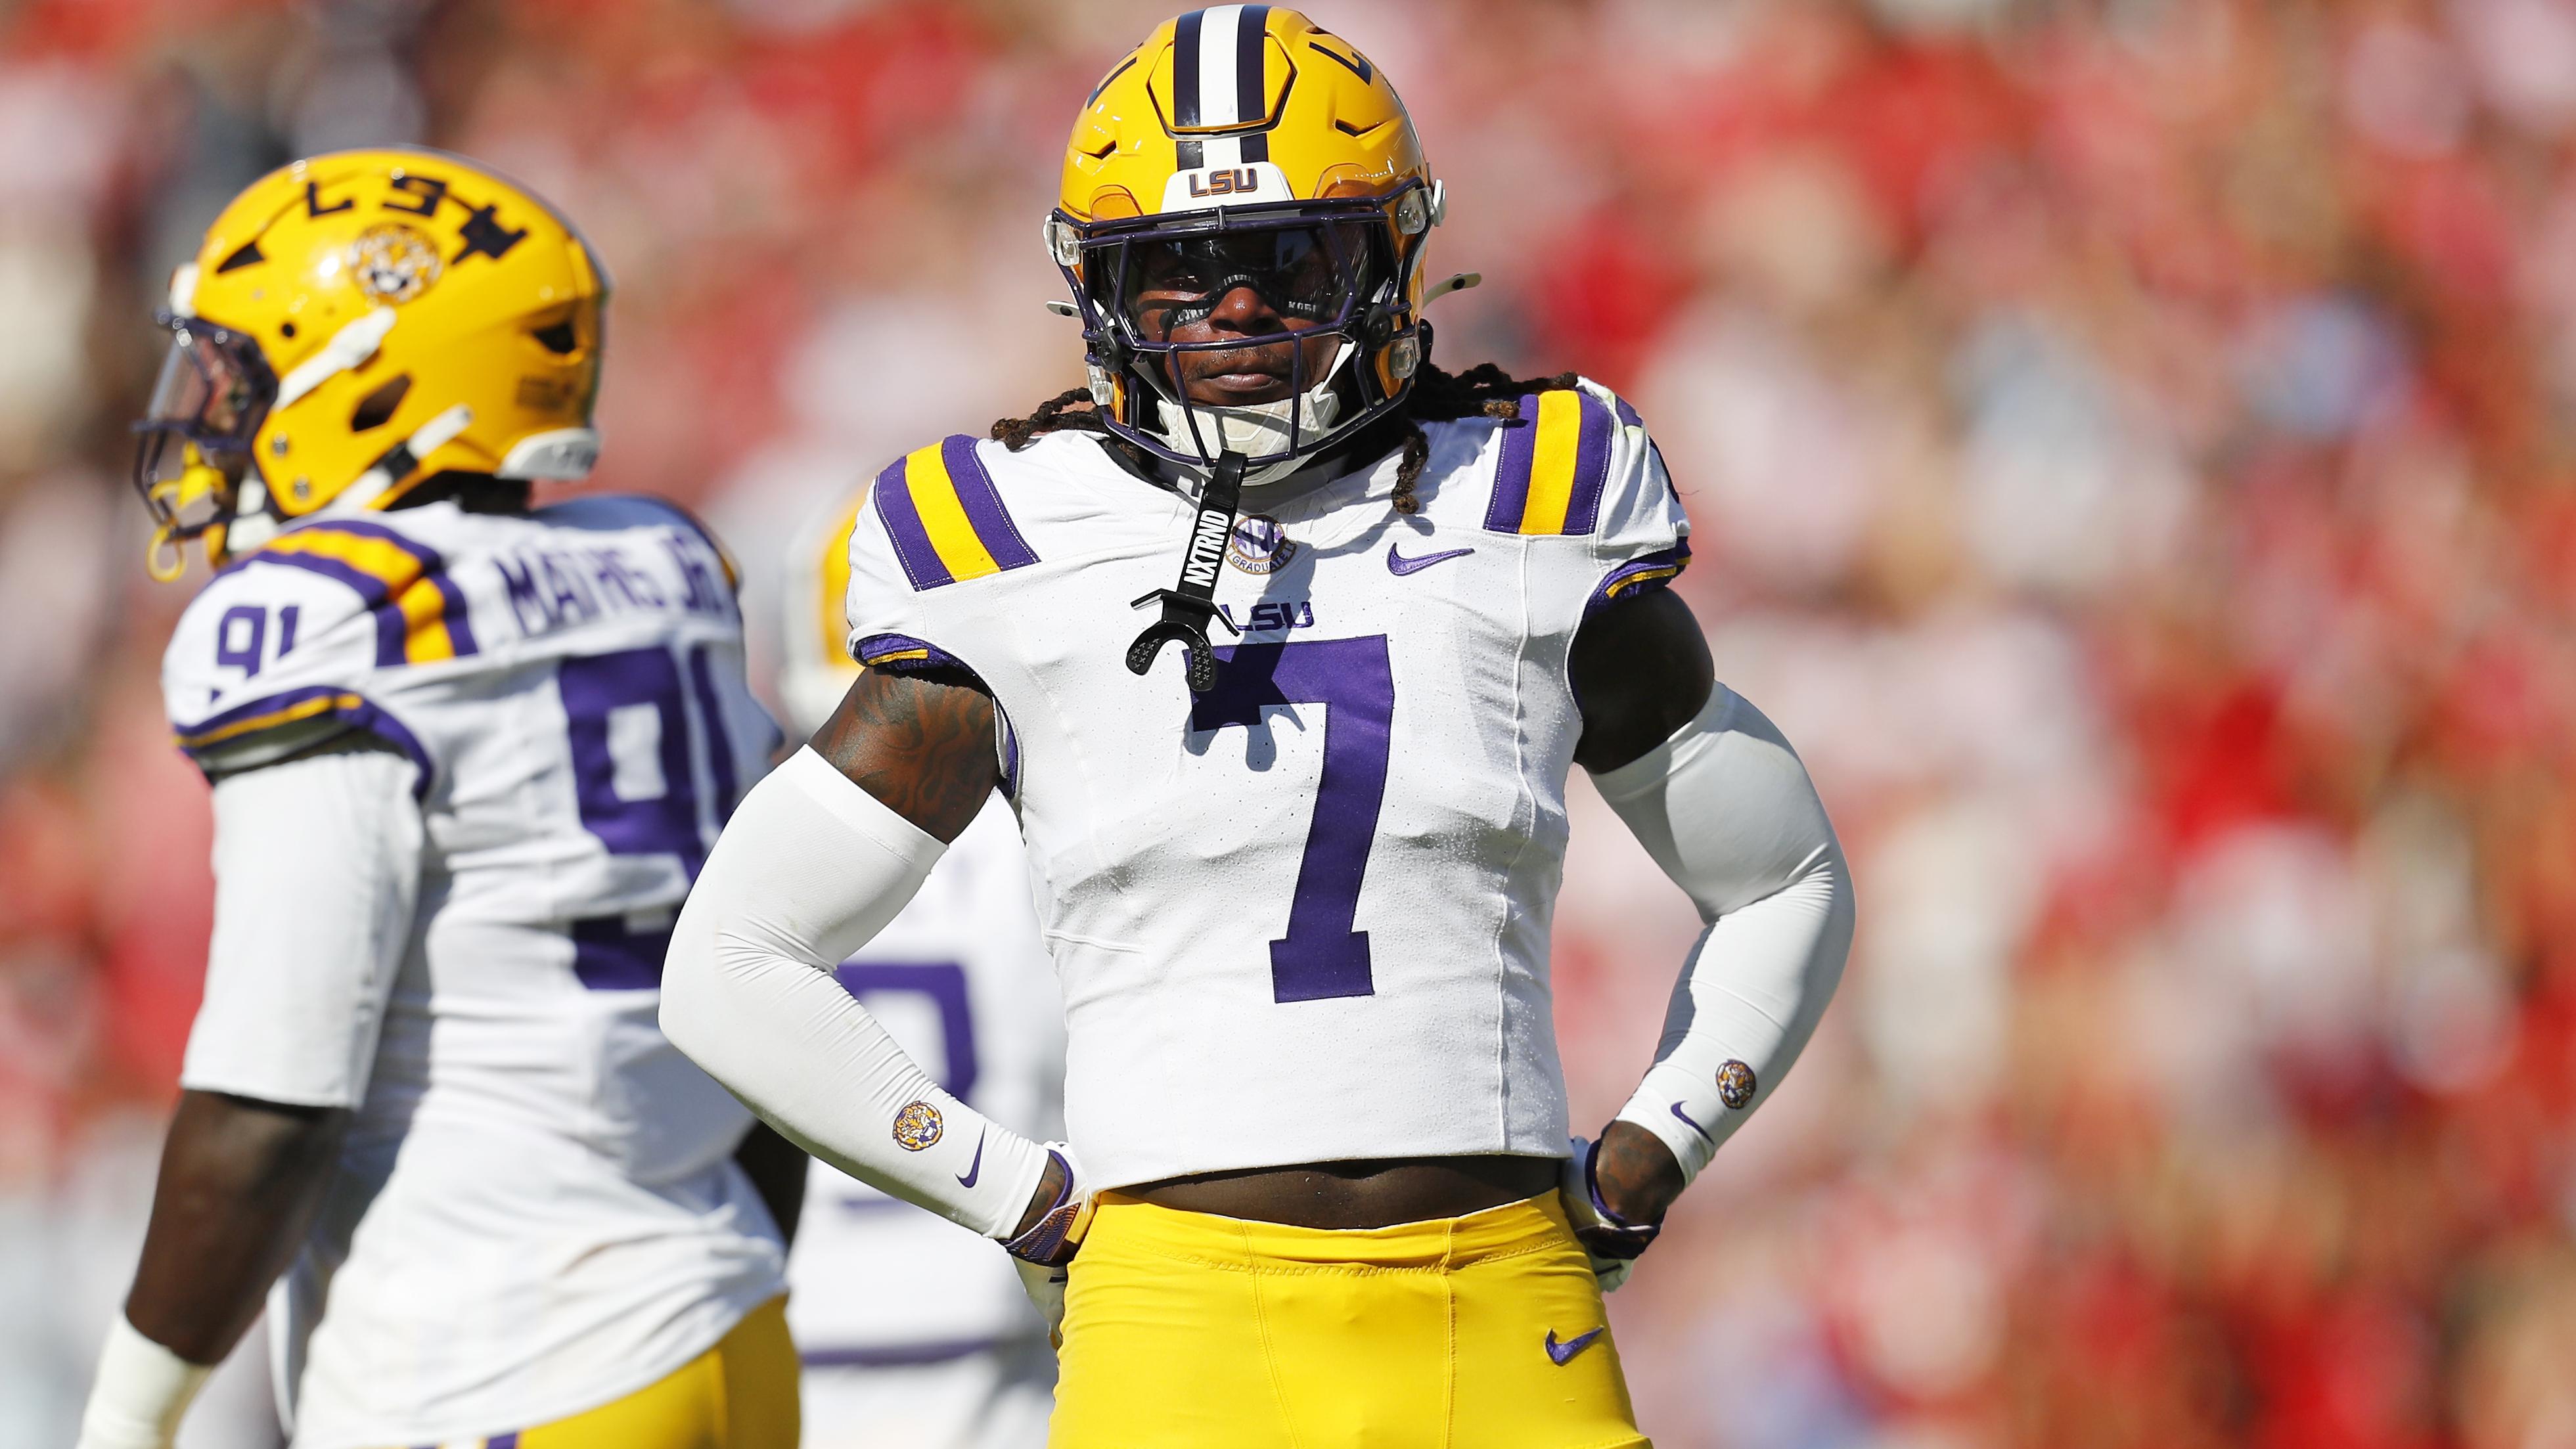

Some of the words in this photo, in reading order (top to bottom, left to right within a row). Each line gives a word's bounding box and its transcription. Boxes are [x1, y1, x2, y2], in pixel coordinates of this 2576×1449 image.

[1188, 167, 1258, 198] LSU
[1183, 509, 1230, 588] NXTRND
[1232, 551, 1290, 573] GRADUATE
[1219, 600, 1315, 632] LSU
[210, 604, 300, 705] 91
[1182, 633, 1395, 1004] 7
